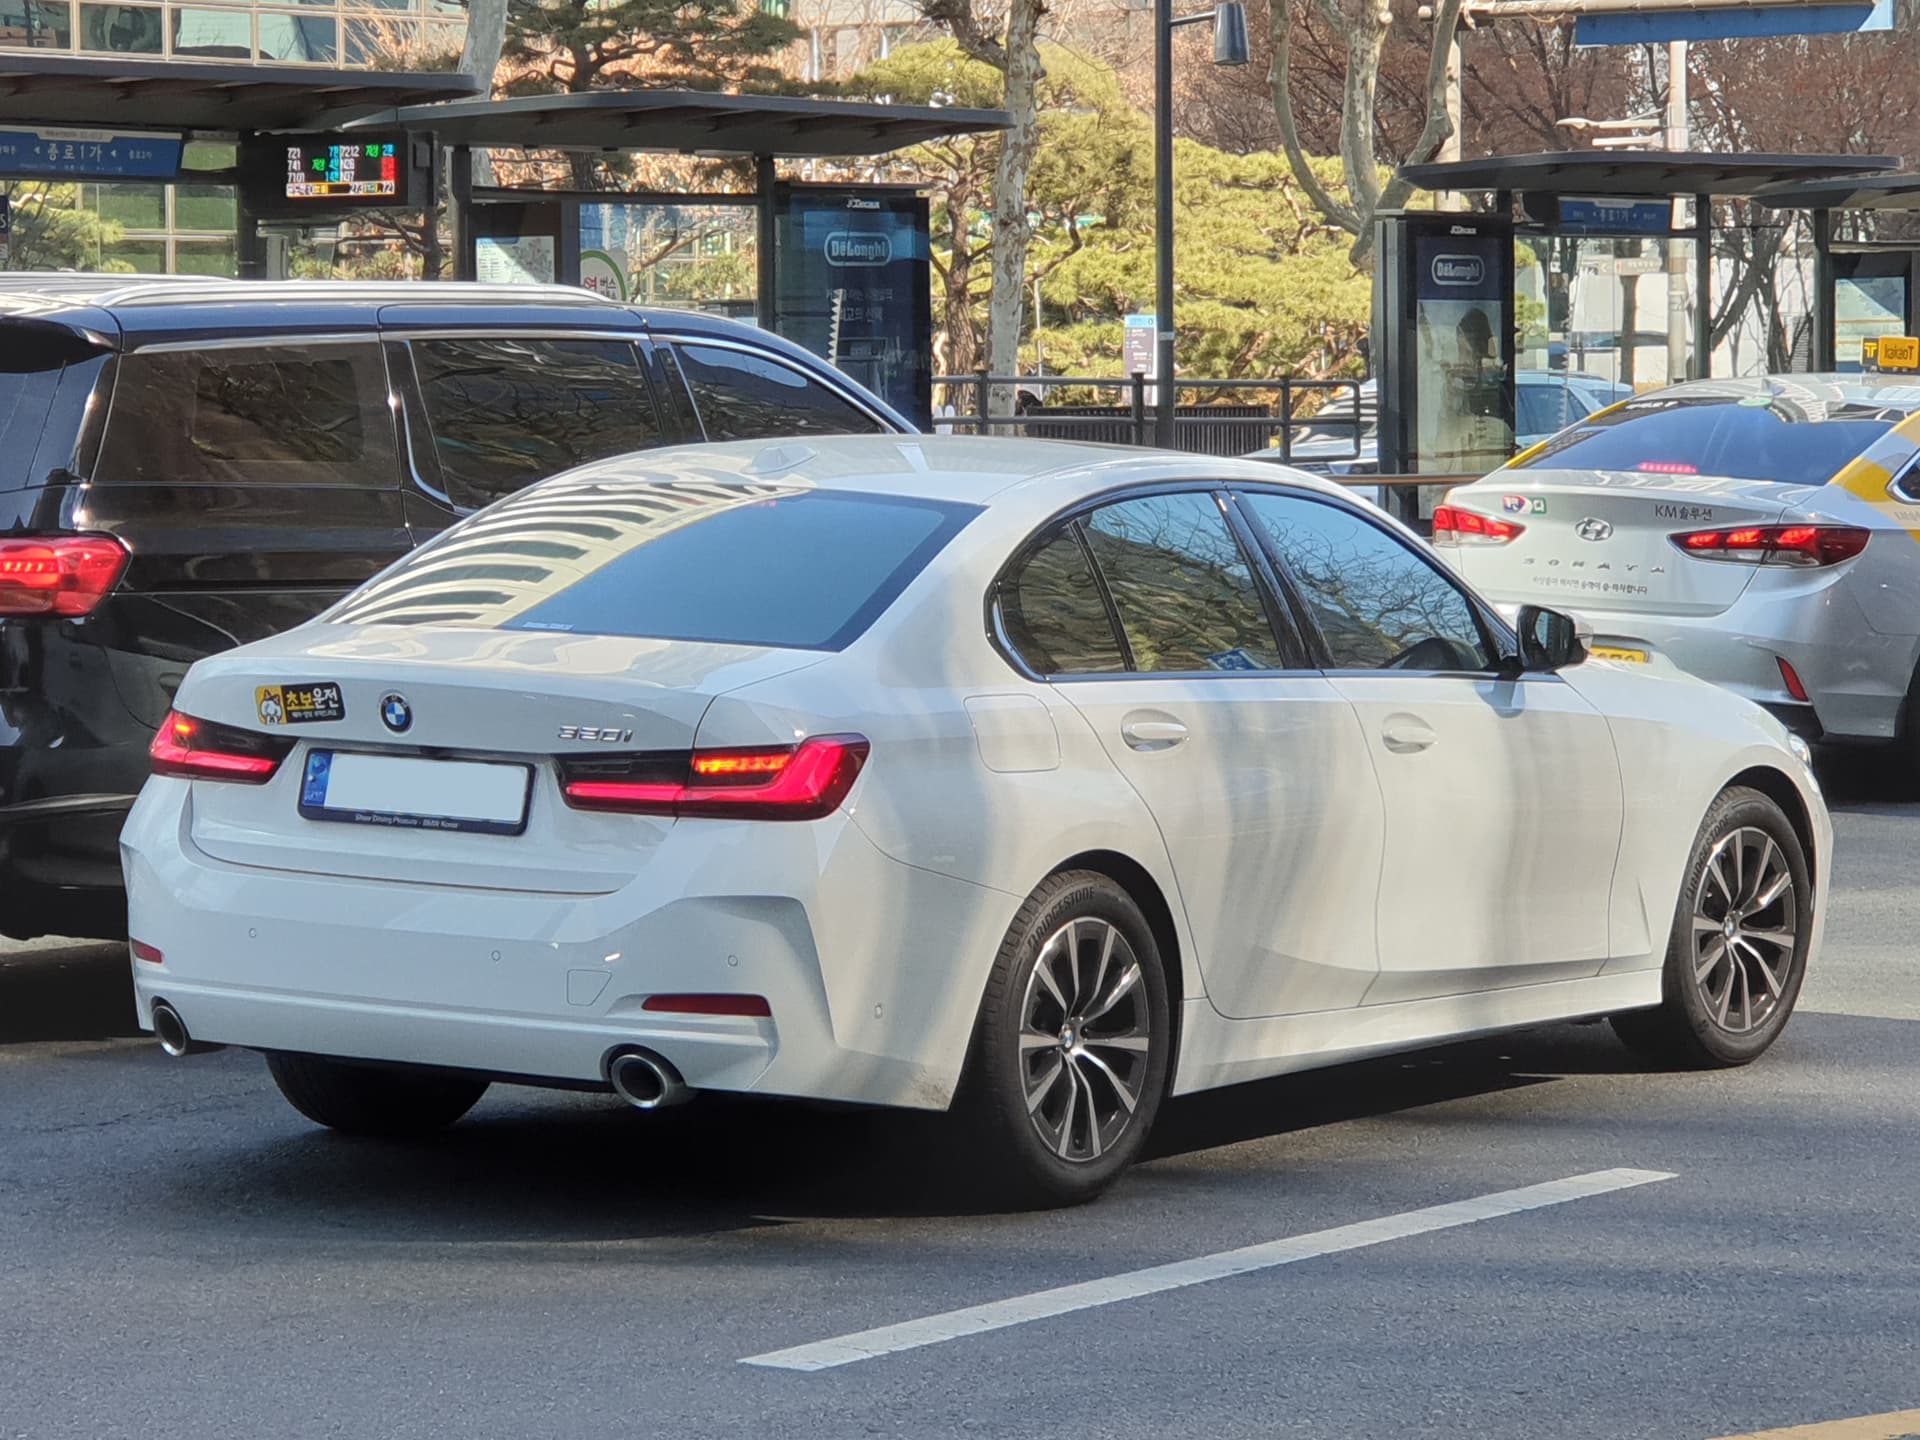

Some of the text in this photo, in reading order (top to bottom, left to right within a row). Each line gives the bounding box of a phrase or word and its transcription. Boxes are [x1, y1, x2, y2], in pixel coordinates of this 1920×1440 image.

[47, 143, 103, 162] 종로1가
[1654, 503, 1713, 522] KM솔루션
[1522, 557, 1666, 574] SONATA
[286, 687, 340, 712] 초보운전
[1027, 887, 1096, 949] BRIDGESTONE
